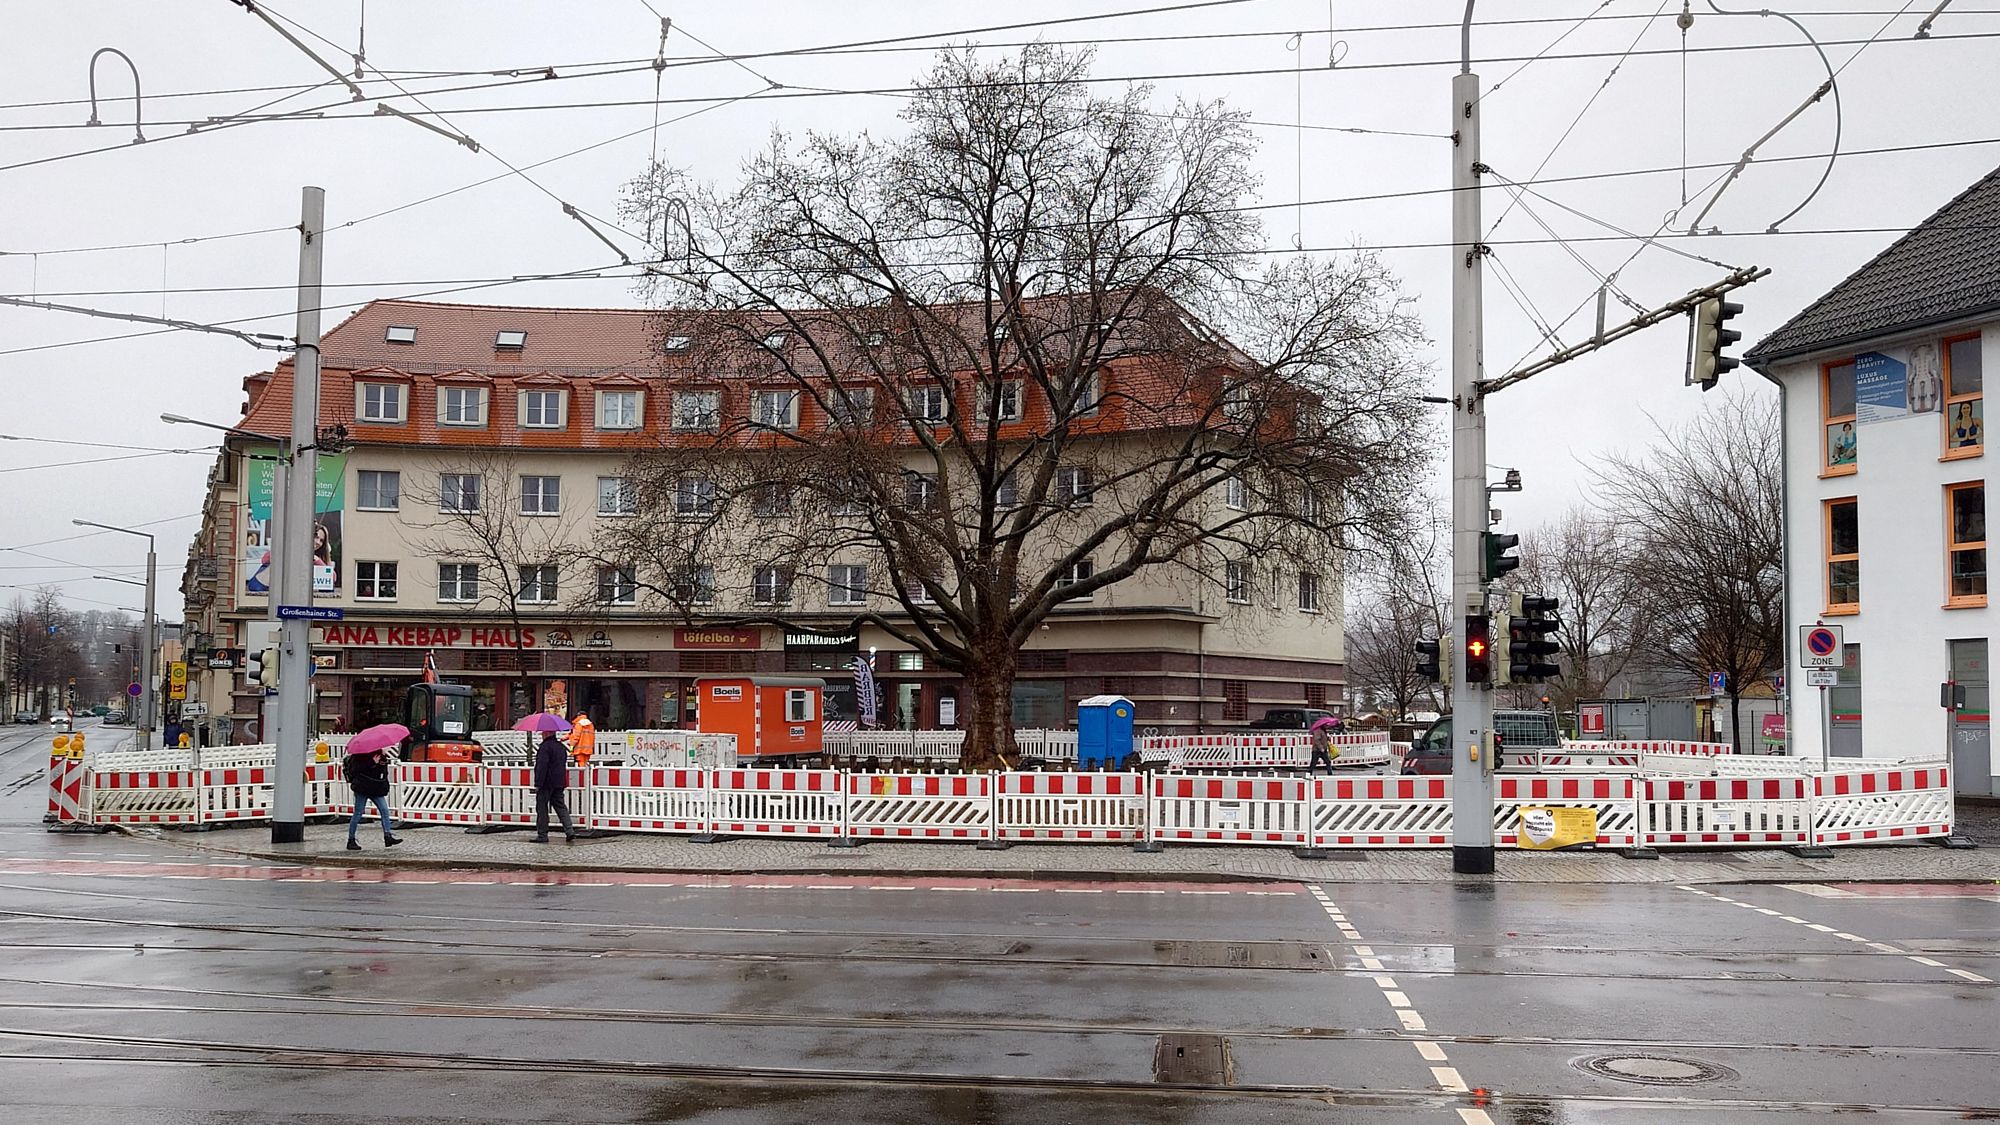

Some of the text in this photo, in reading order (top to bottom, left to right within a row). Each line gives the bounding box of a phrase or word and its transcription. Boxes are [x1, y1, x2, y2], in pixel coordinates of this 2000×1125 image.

[1857, 360, 1885, 370] GRAVITY
[1857, 375, 1888, 384] MASSAGE
[282, 608, 339, 618] Großenhainer Str.
[387, 626, 462, 646] KEBAP
[471, 627, 536, 648] HAUS
